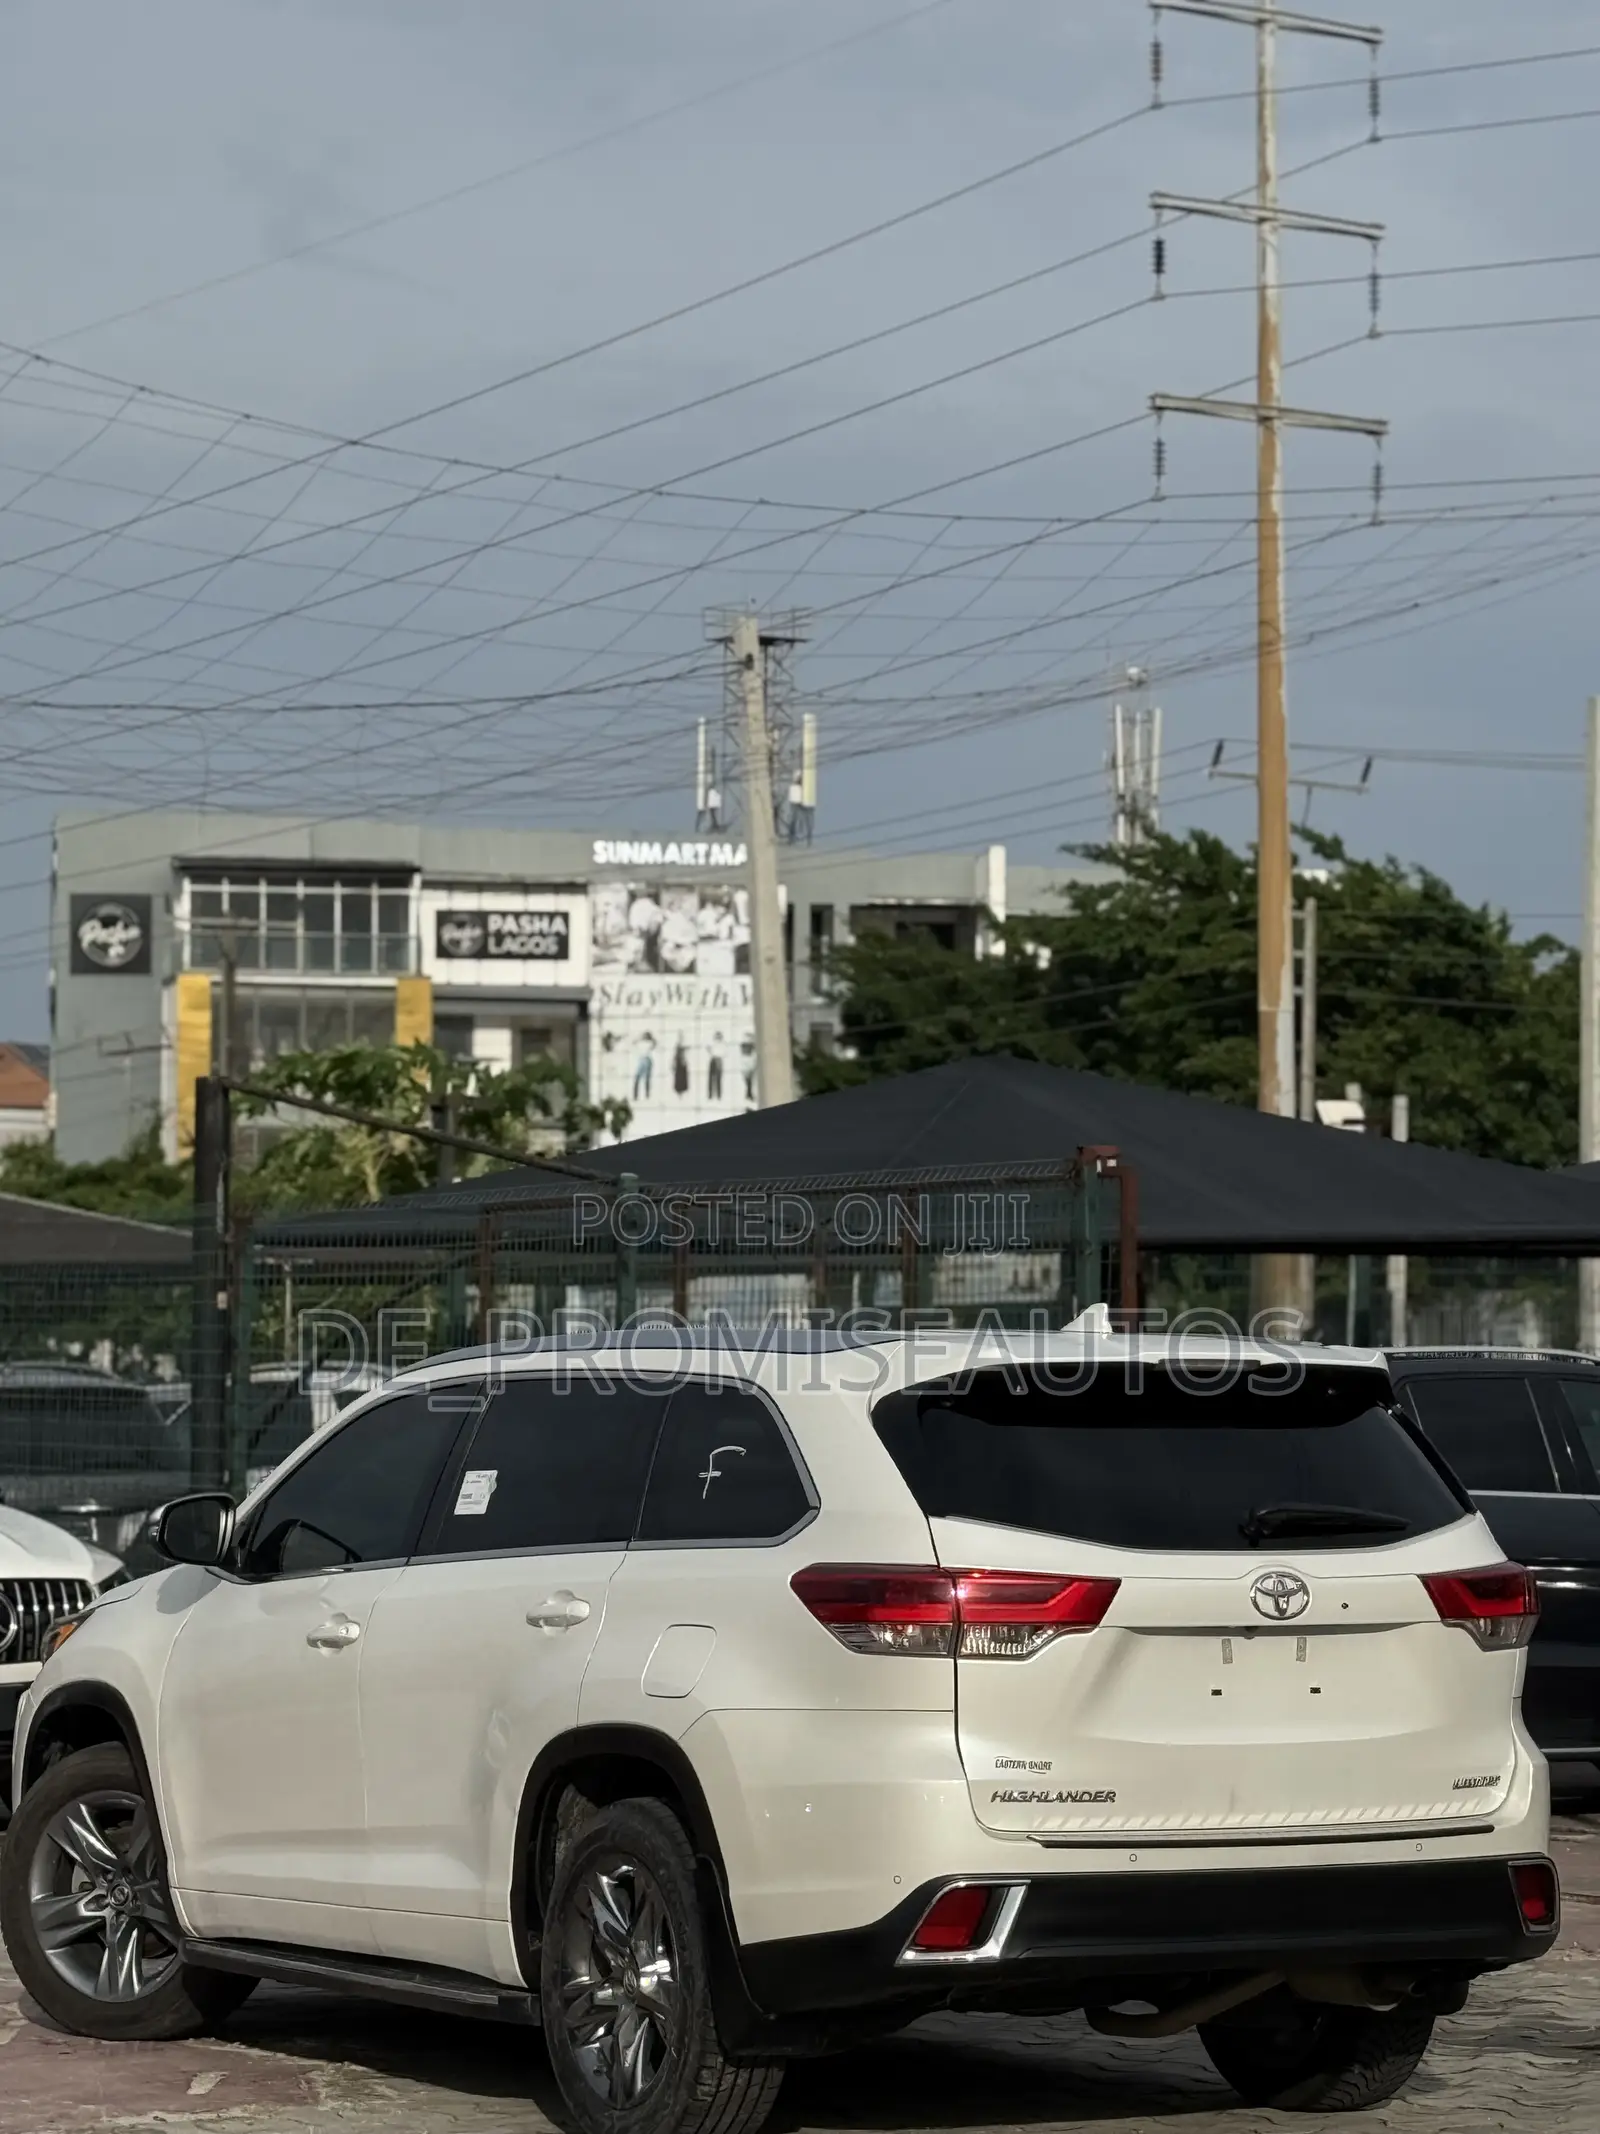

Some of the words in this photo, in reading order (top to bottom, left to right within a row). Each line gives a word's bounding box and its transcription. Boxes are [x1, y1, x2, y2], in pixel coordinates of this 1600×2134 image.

[486, 913, 568, 936] PASHA
[486, 934, 559, 956] LAGOS
[990, 1789, 1117, 1803] HIGHLANDER
